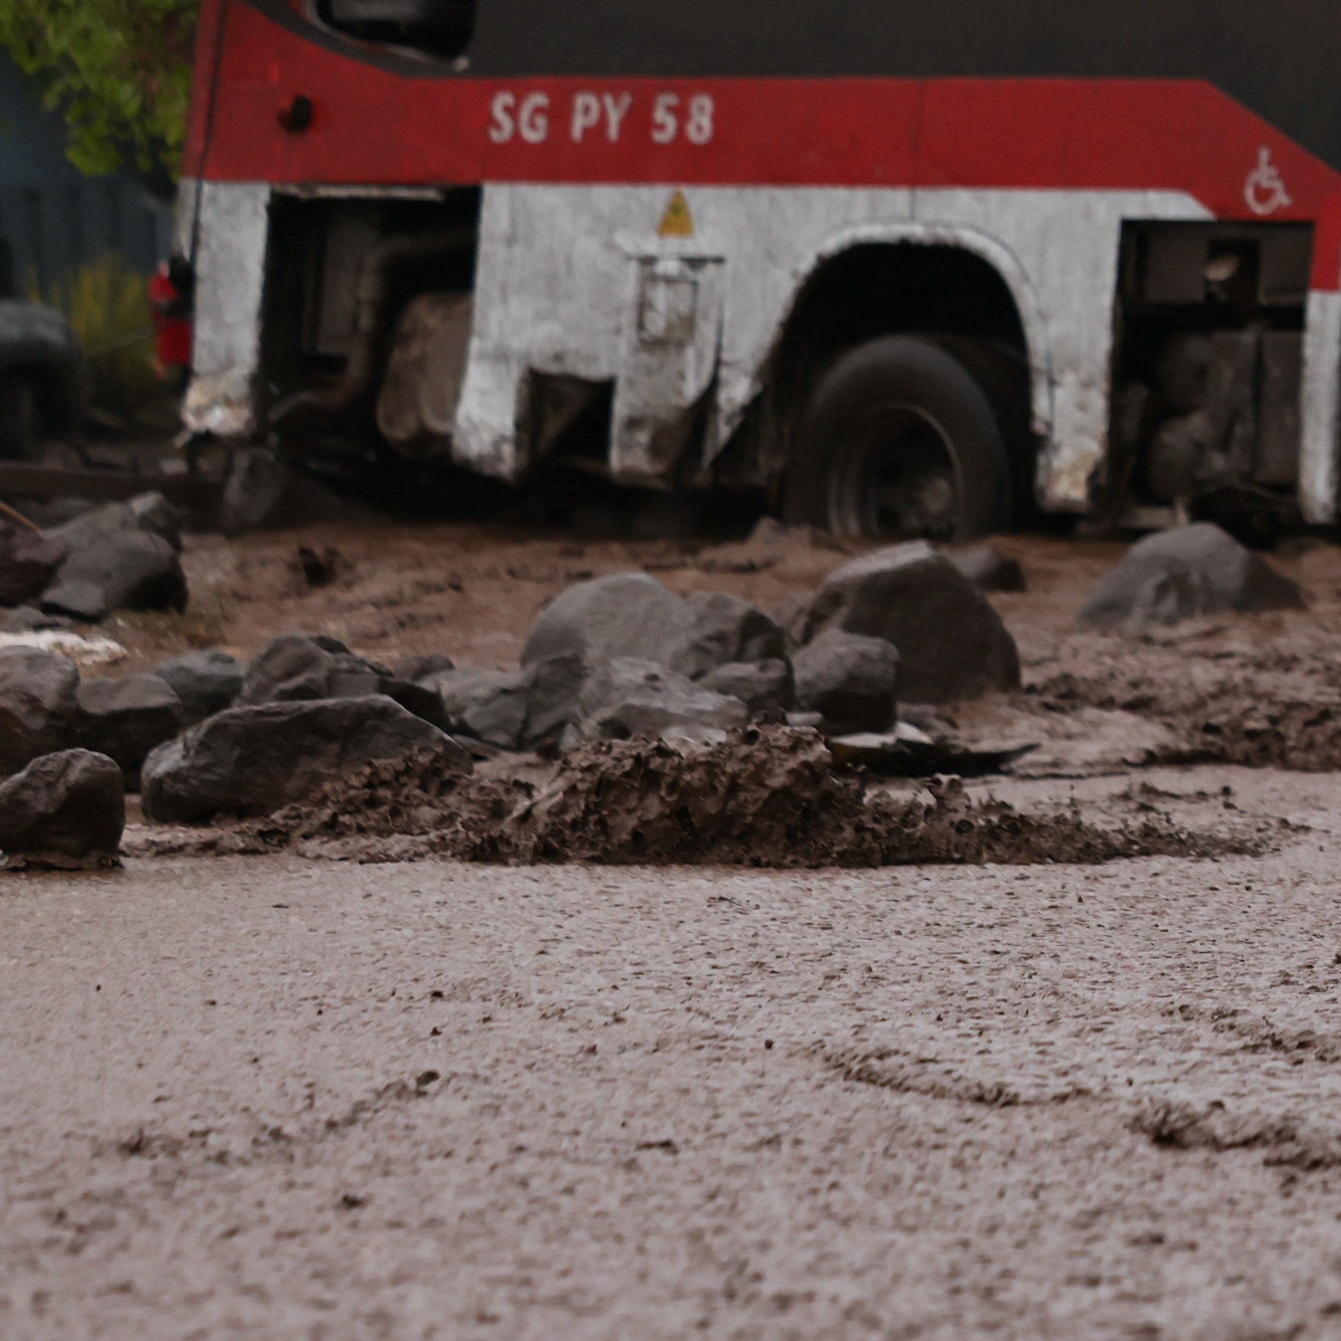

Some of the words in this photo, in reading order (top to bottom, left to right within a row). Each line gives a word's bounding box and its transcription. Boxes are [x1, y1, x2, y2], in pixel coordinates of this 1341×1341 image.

[489, 91, 550, 144] SG
[571, 90, 632, 144] PY
[651, 91, 714, 145] 58
